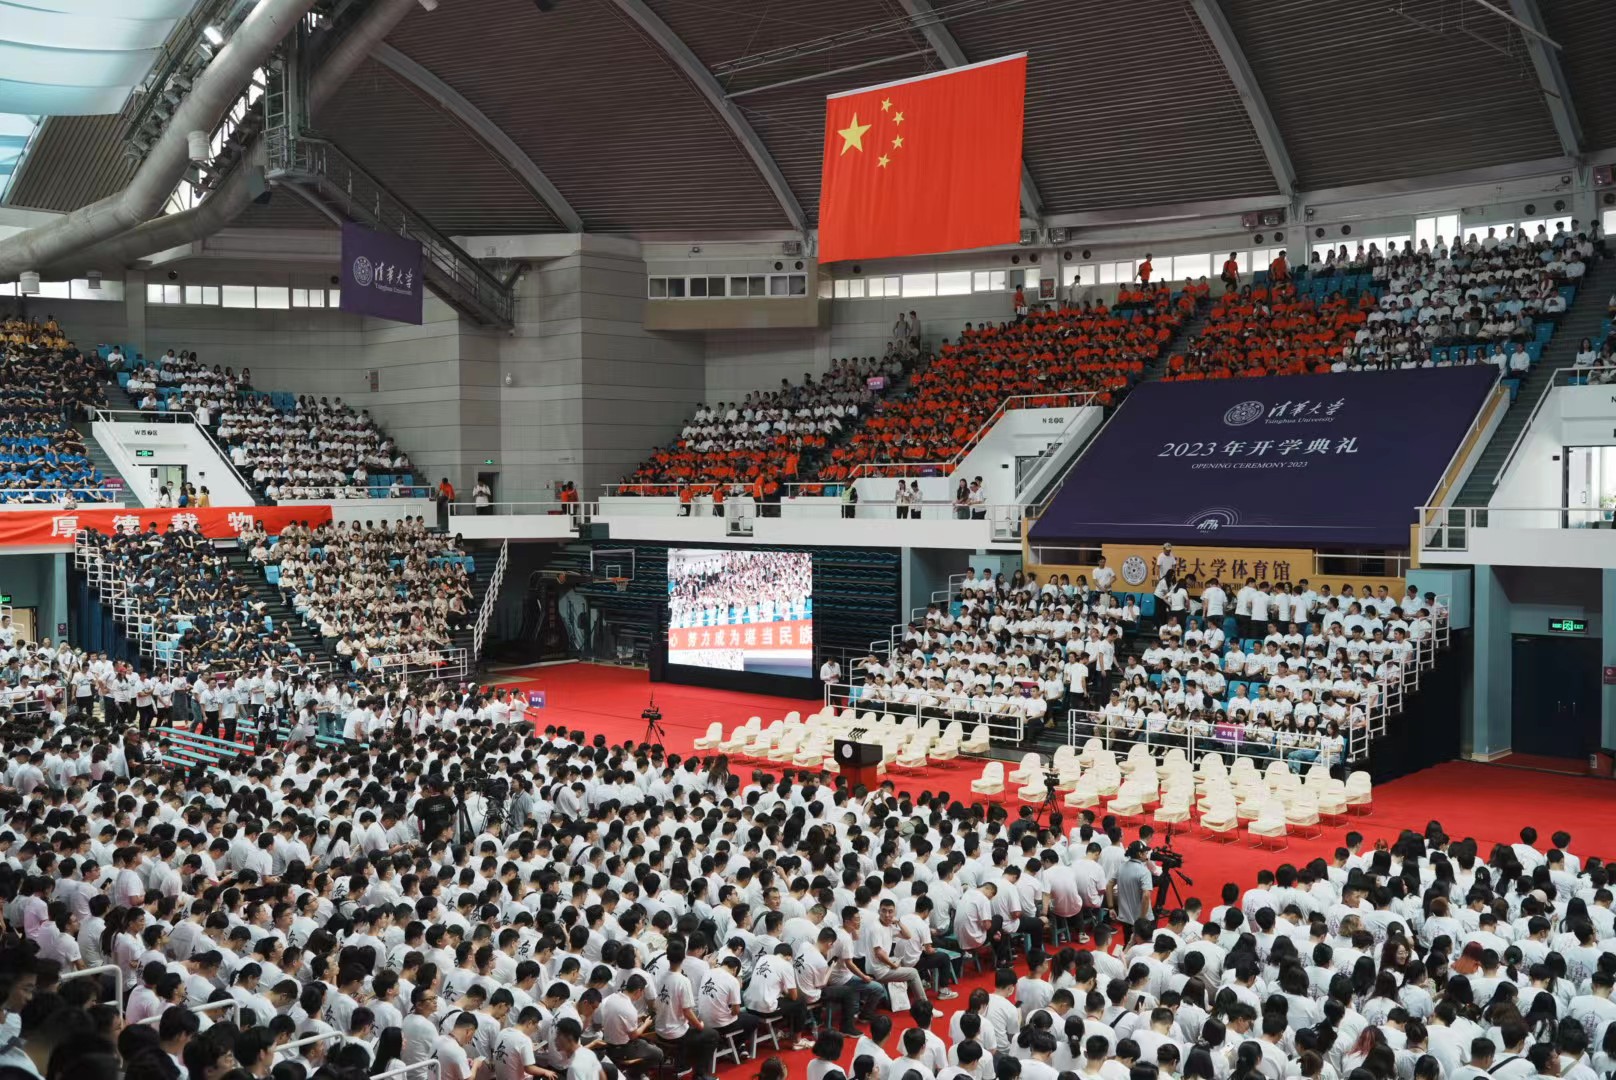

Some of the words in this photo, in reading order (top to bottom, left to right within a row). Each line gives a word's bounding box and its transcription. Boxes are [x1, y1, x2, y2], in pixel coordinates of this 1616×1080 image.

[1157, 436, 1358, 457] 2023年开学典礼
